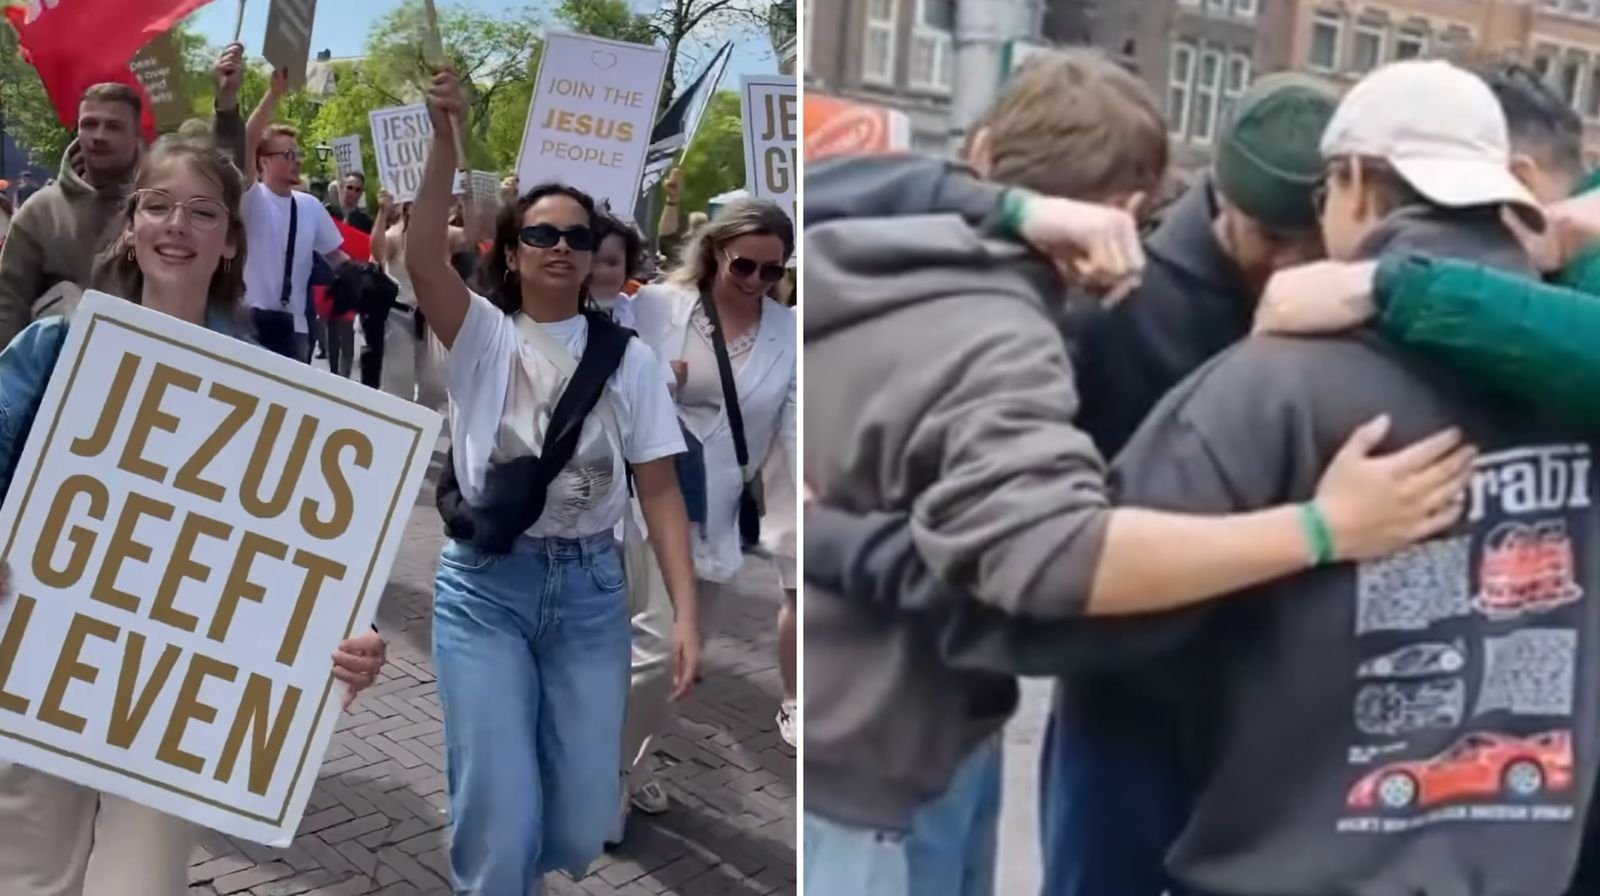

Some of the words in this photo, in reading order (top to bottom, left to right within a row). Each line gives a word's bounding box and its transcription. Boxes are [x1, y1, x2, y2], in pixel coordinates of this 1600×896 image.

[548, 77, 596, 99] JOIN
[603, 86, 644, 109] THE
[382, 112, 430, 141] JESU
[541, 108, 635, 143] JESUS
[385, 139, 427, 167] LOV
[540, 139, 624, 168] PEOPLE
[764, 146, 797, 194] G
[70, 351, 374, 540] JEZUS
[1468, 443, 1591, 521] rabi
[31, 474, 348, 667] GEEFT
[0, 593, 303, 797] LEVEN
